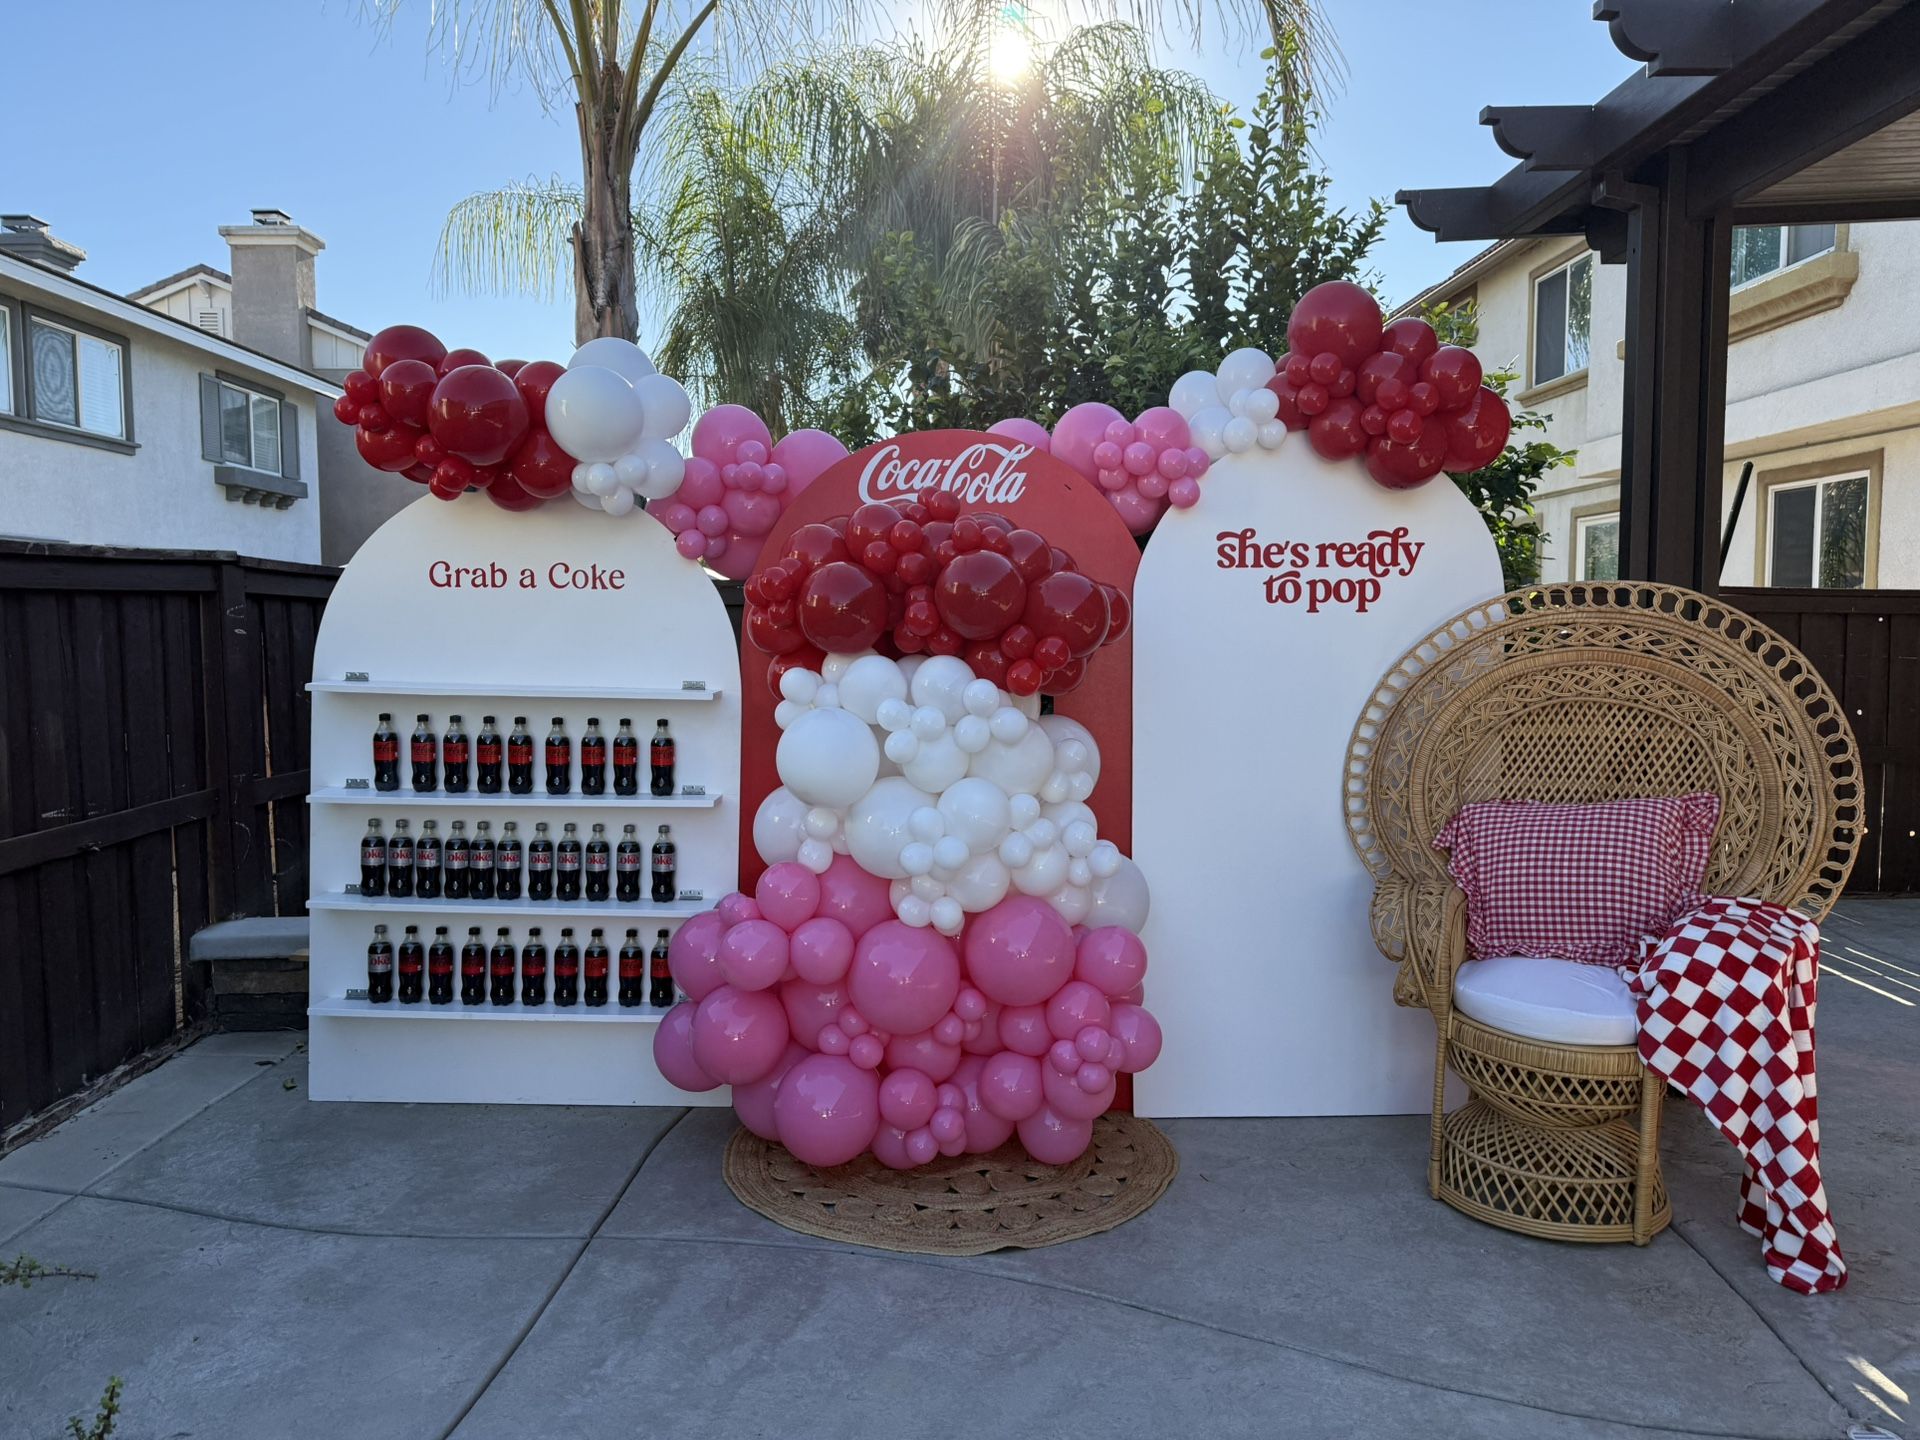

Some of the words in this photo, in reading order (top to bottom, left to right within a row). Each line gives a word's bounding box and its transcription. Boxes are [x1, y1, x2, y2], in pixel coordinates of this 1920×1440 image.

[858, 443, 1035, 504] Coca-Cola
[429, 560, 507, 588] Grab
[519, 568, 537, 589] a
[548, 562, 626, 590] Coke
[1216, 528, 1309, 568] she's
[1315, 527, 1425, 577] ready
[1263, 570, 1302, 603] to
[1306, 577, 1381, 613] pop
